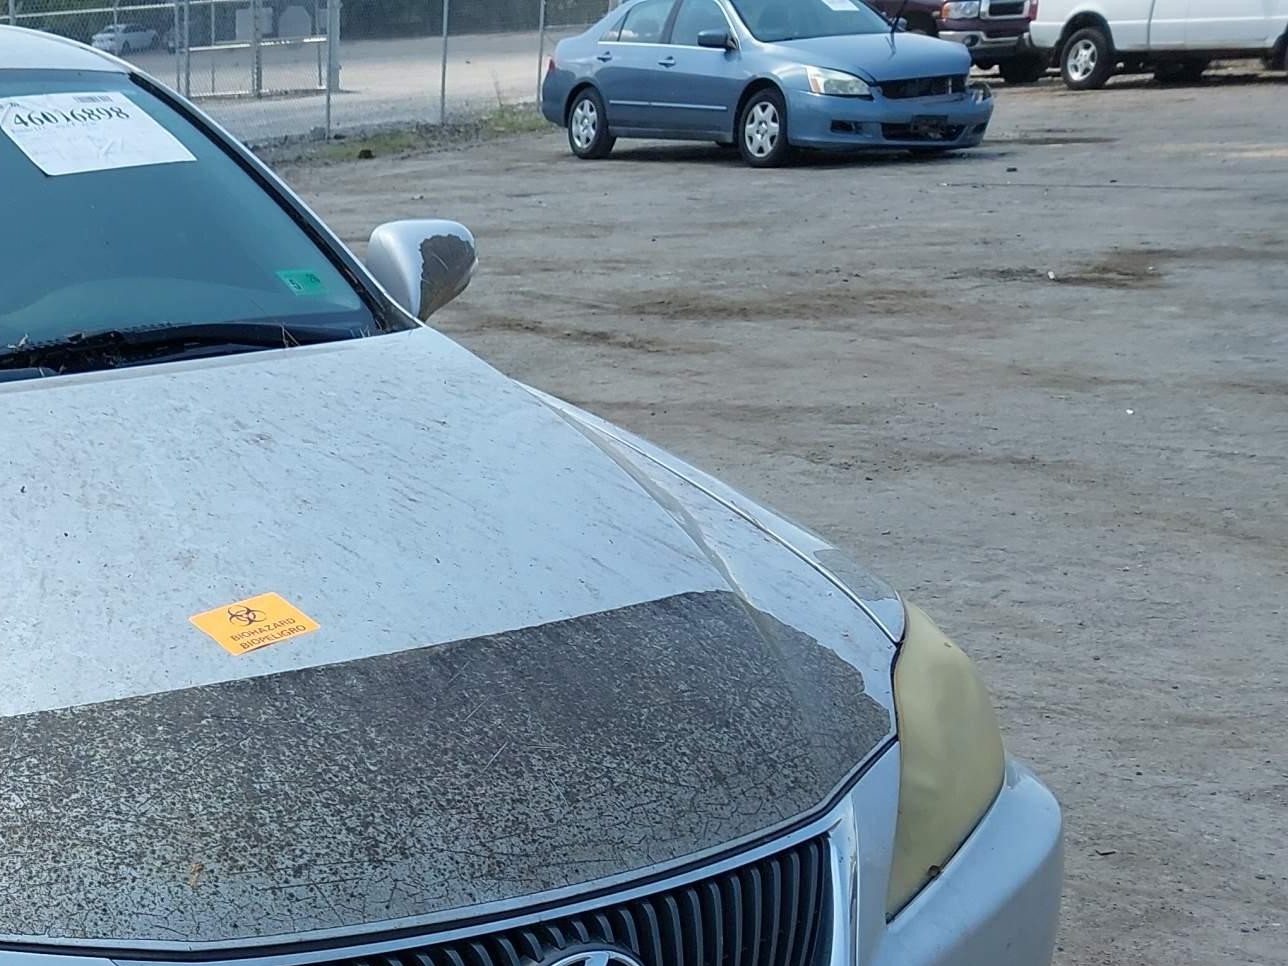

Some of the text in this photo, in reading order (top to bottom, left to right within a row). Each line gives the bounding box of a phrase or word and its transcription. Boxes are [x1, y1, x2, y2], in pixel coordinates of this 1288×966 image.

[14, 107, 130, 127] 46016898
[230, 617, 296, 641] BIOHAZARD
[239, 624, 307, 650] BIOPELIGRO
